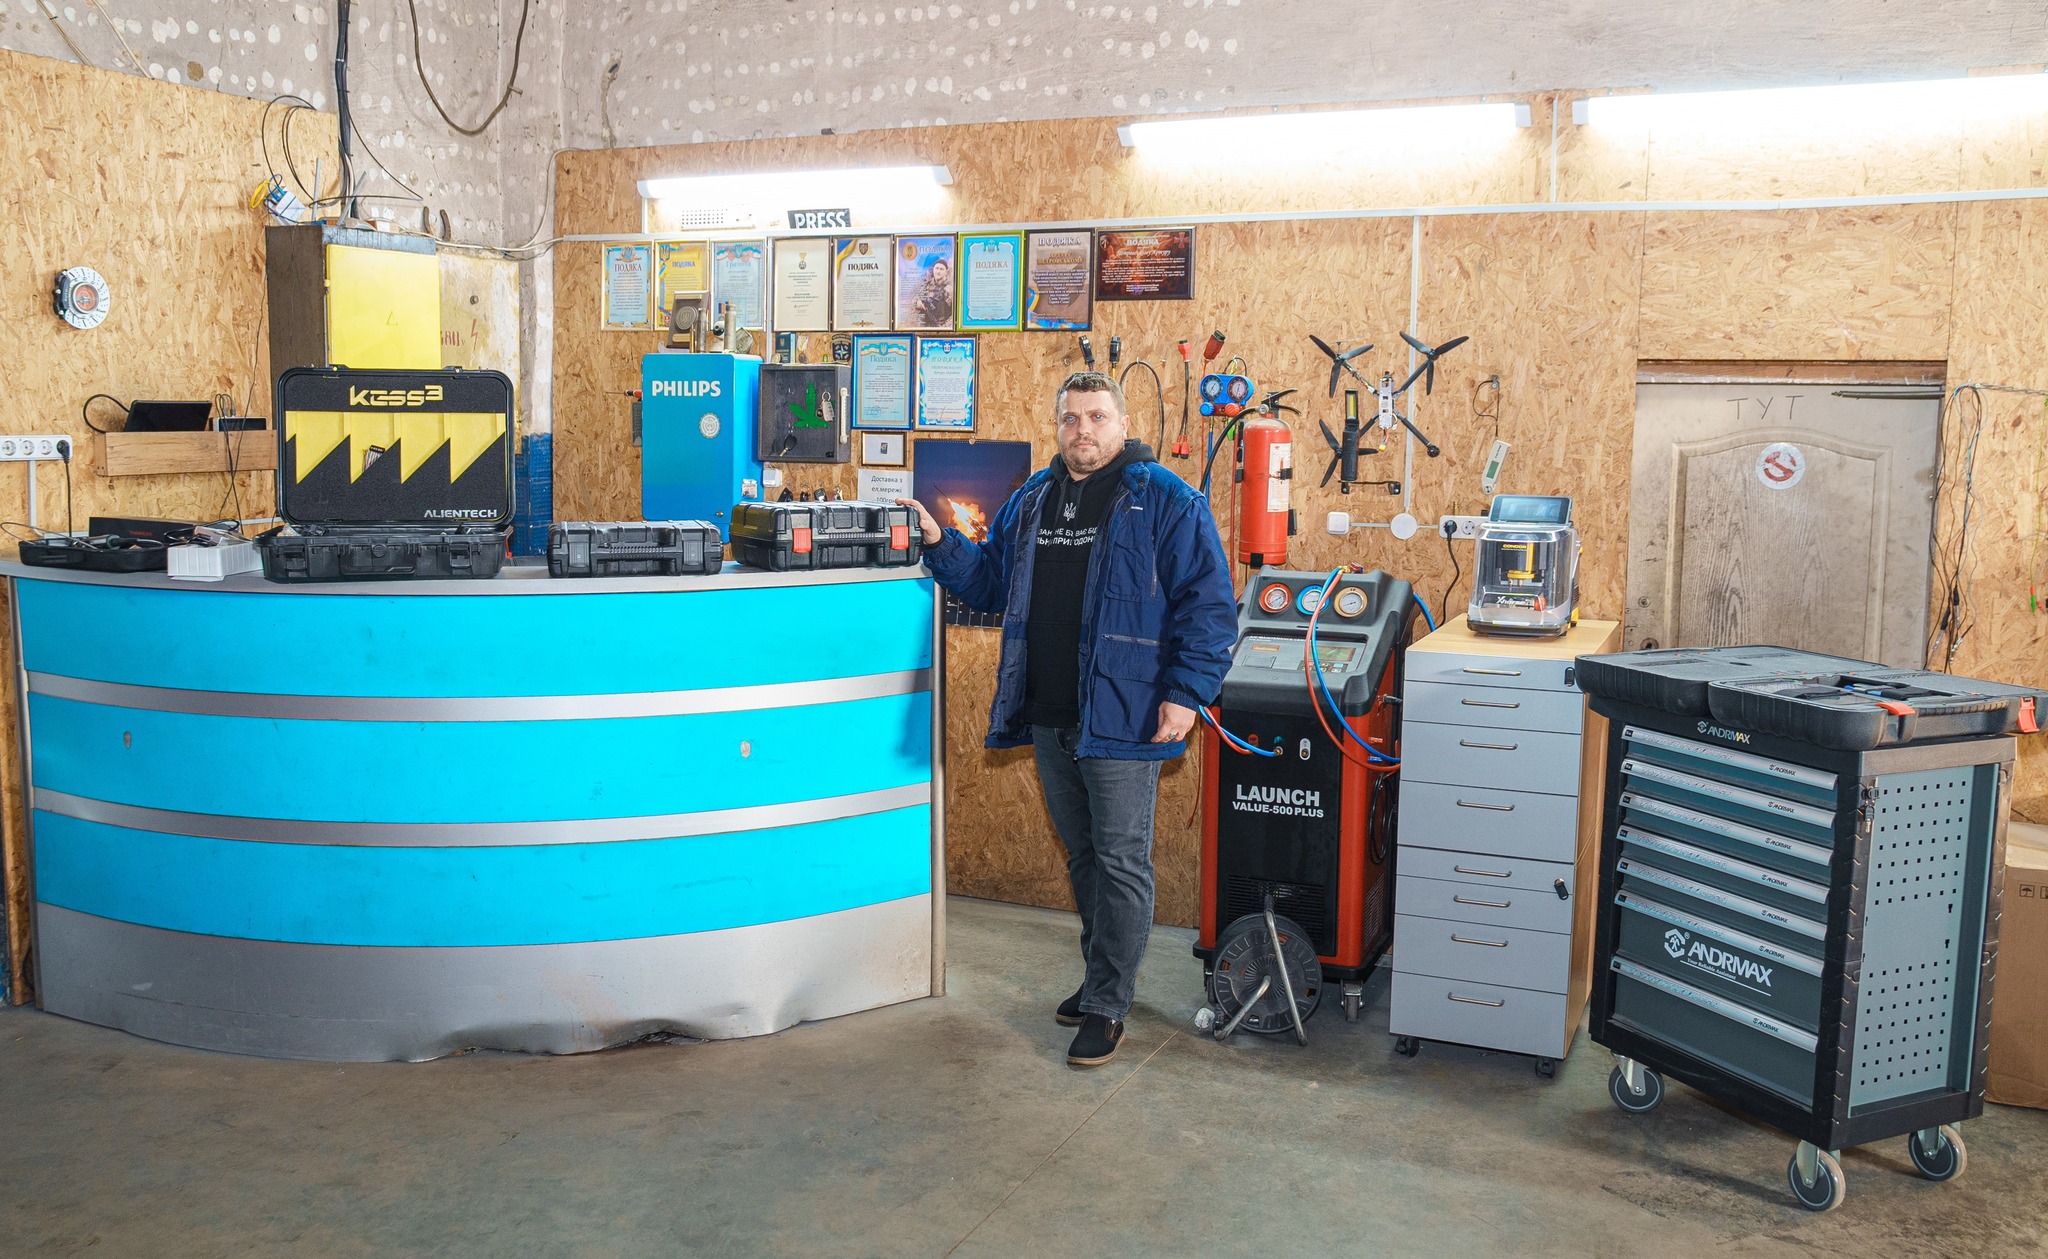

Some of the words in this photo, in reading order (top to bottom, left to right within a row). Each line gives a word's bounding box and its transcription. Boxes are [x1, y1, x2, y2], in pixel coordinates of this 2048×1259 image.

[794, 211, 846, 229] PRESS
[1038, 237, 1081, 247] ПОДЯКА
[920, 245, 951, 253] ПОДЯКА
[614, 263, 643, 272] ПОДЯКА
[848, 263, 879, 271] ПОДЯКА
[975, 261, 1009, 269] ПОДЯКА
[870, 355, 897, 363] Подяка
[652, 380, 721, 397] PHILIPS
[423, 509, 498, 518] ALIENTECH
[1706, 725, 1751, 745] ANDRMAX
[1236, 784, 1320, 807] LAUNCH
[1232, 801, 1293, 816] VALUE-500
[1294, 807, 1324, 818] PLUS
[1688, 941, 1773, 988] ANDRMAX
